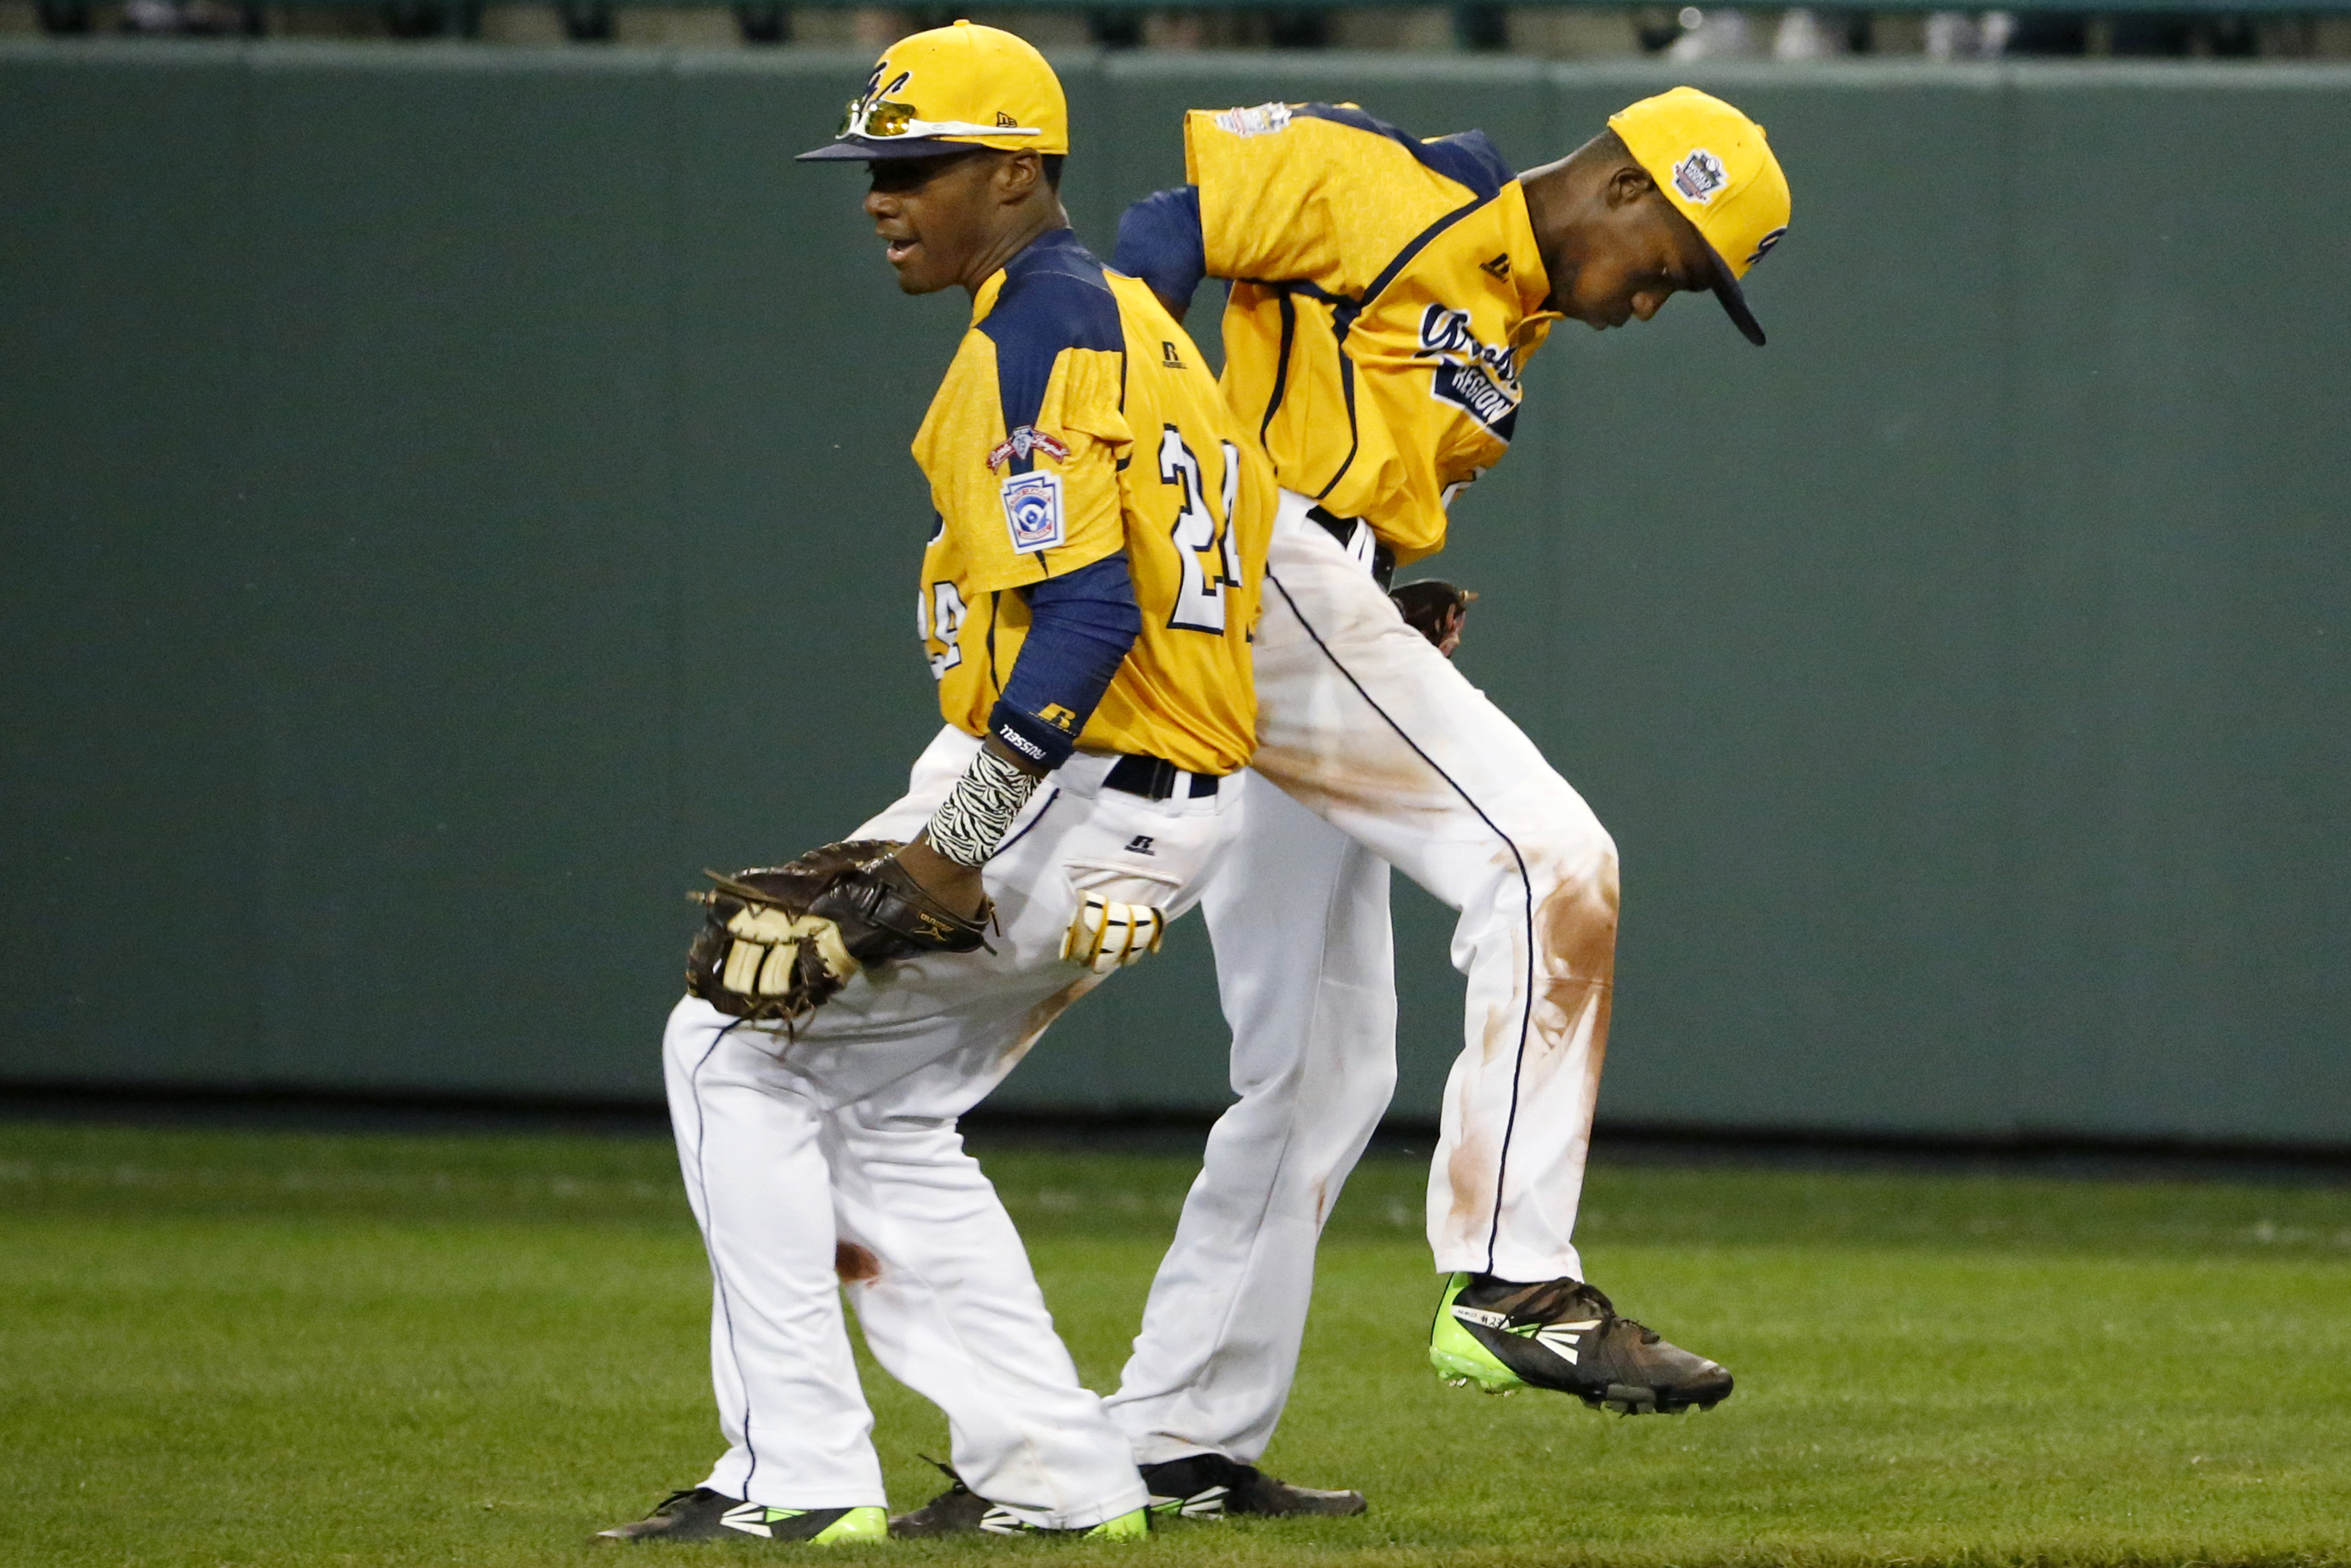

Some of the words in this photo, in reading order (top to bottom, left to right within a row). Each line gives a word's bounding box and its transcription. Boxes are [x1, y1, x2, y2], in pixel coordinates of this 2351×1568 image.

[1687, 160, 1712, 189] WORLD
[1452, 366, 1510, 424] REGION
[999, 723, 1046, 760] RUSSELL
